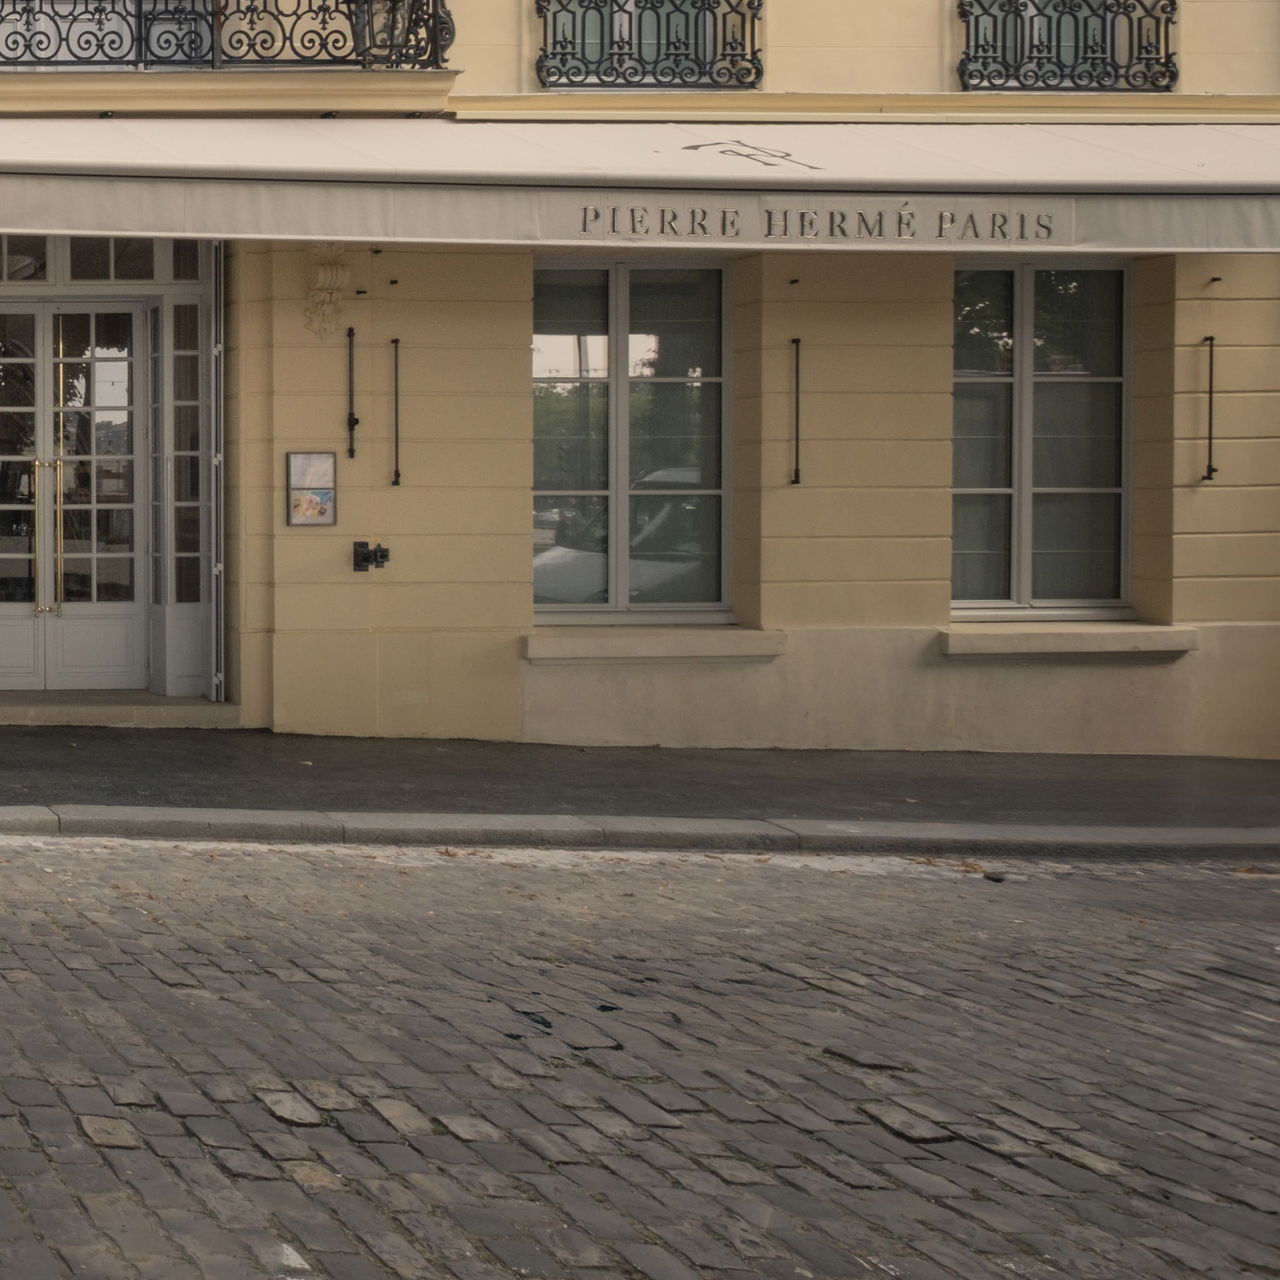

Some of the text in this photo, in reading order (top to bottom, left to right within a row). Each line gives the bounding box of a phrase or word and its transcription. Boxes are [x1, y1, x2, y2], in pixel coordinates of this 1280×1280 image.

[580, 201, 1053, 241] PIERRE HERMÉ PARIS
